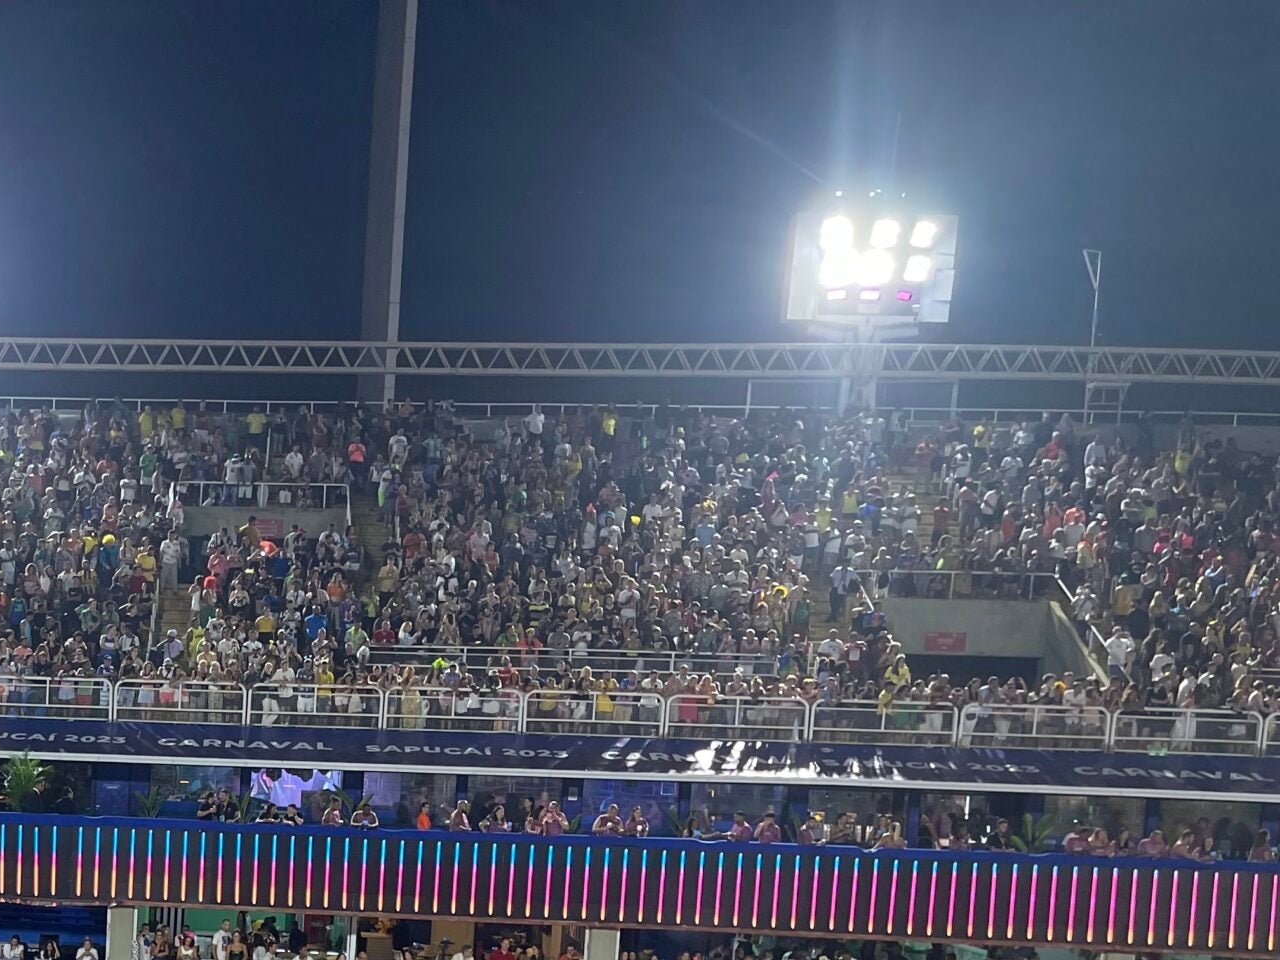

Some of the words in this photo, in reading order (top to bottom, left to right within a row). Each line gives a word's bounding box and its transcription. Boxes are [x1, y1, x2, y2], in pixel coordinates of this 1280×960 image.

[64, 734, 127, 744] 2023
[158, 738, 334, 751] CARNAVAL
[366, 744, 492, 756] SAPUCAÍ
[501, 748, 569, 758] 2023
[965, 763, 1040, 774] 2023
[1073, 766, 1275, 782] CARNAVAL
